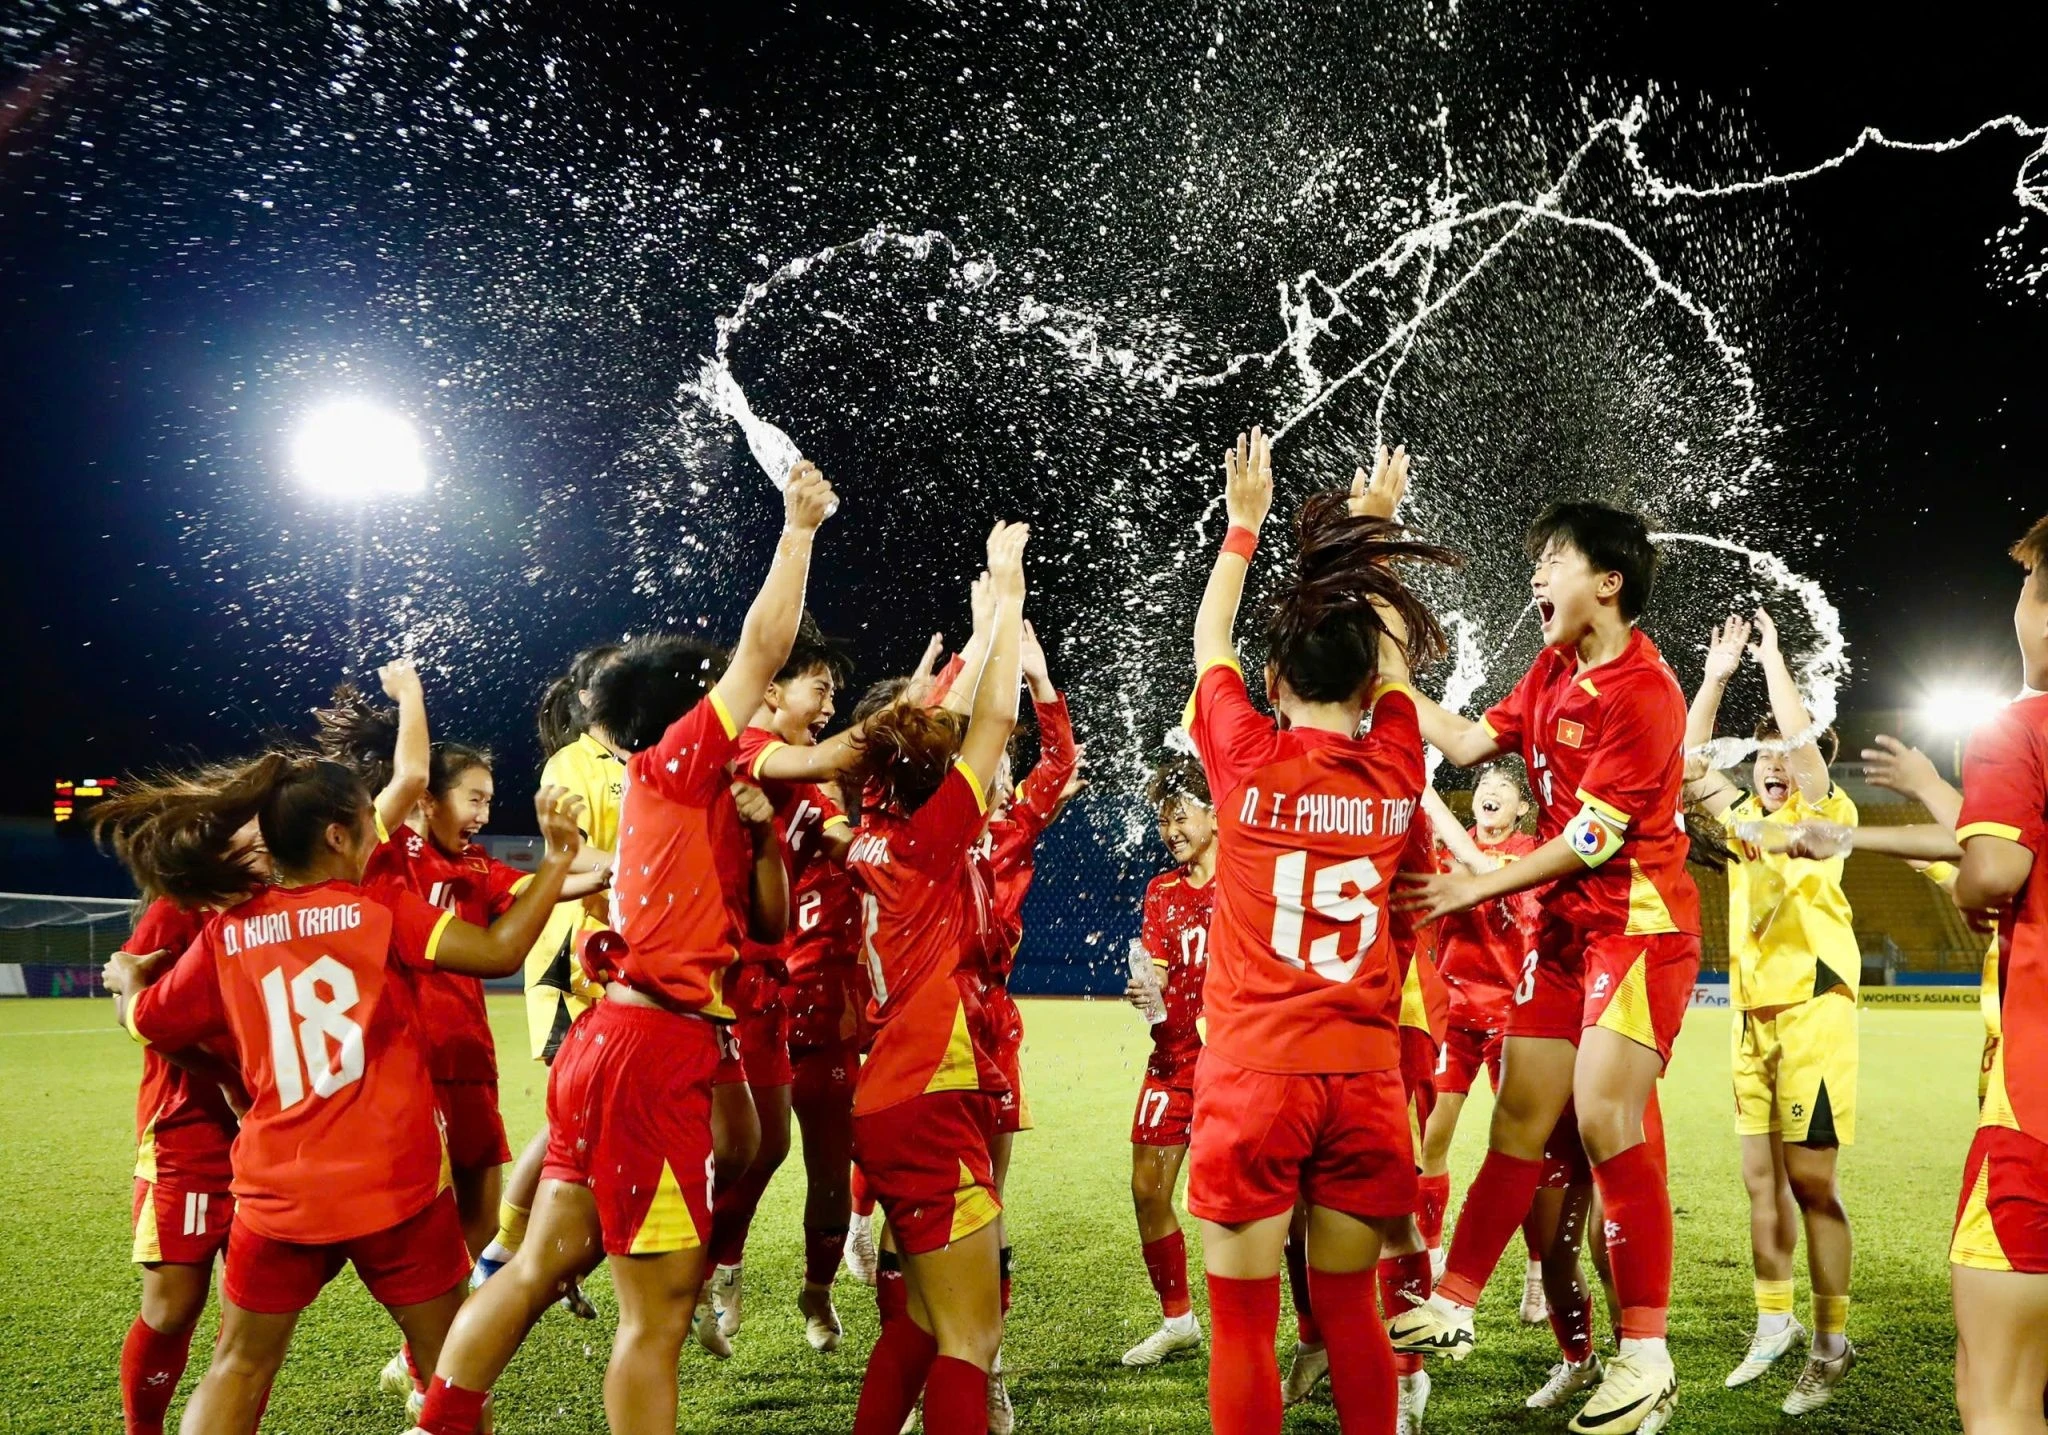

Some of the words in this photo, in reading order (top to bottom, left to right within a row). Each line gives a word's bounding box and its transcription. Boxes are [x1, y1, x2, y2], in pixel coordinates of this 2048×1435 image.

[1270, 792, 1287, 831] T.
[1294, 794, 1374, 836] PHUONG
[296, 902, 361, 938] TRANG
[1270, 850, 1384, 985] 15
[1180, 924, 1207, 967] 17
[1862, 992, 1921, 1004] WOMEN'S
[1922, 993, 1961, 1005] ASIAN
[261, 954, 365, 1112] 18
[1137, 1087, 1170, 1129] 17
[183, 1191, 209, 1236] 11
